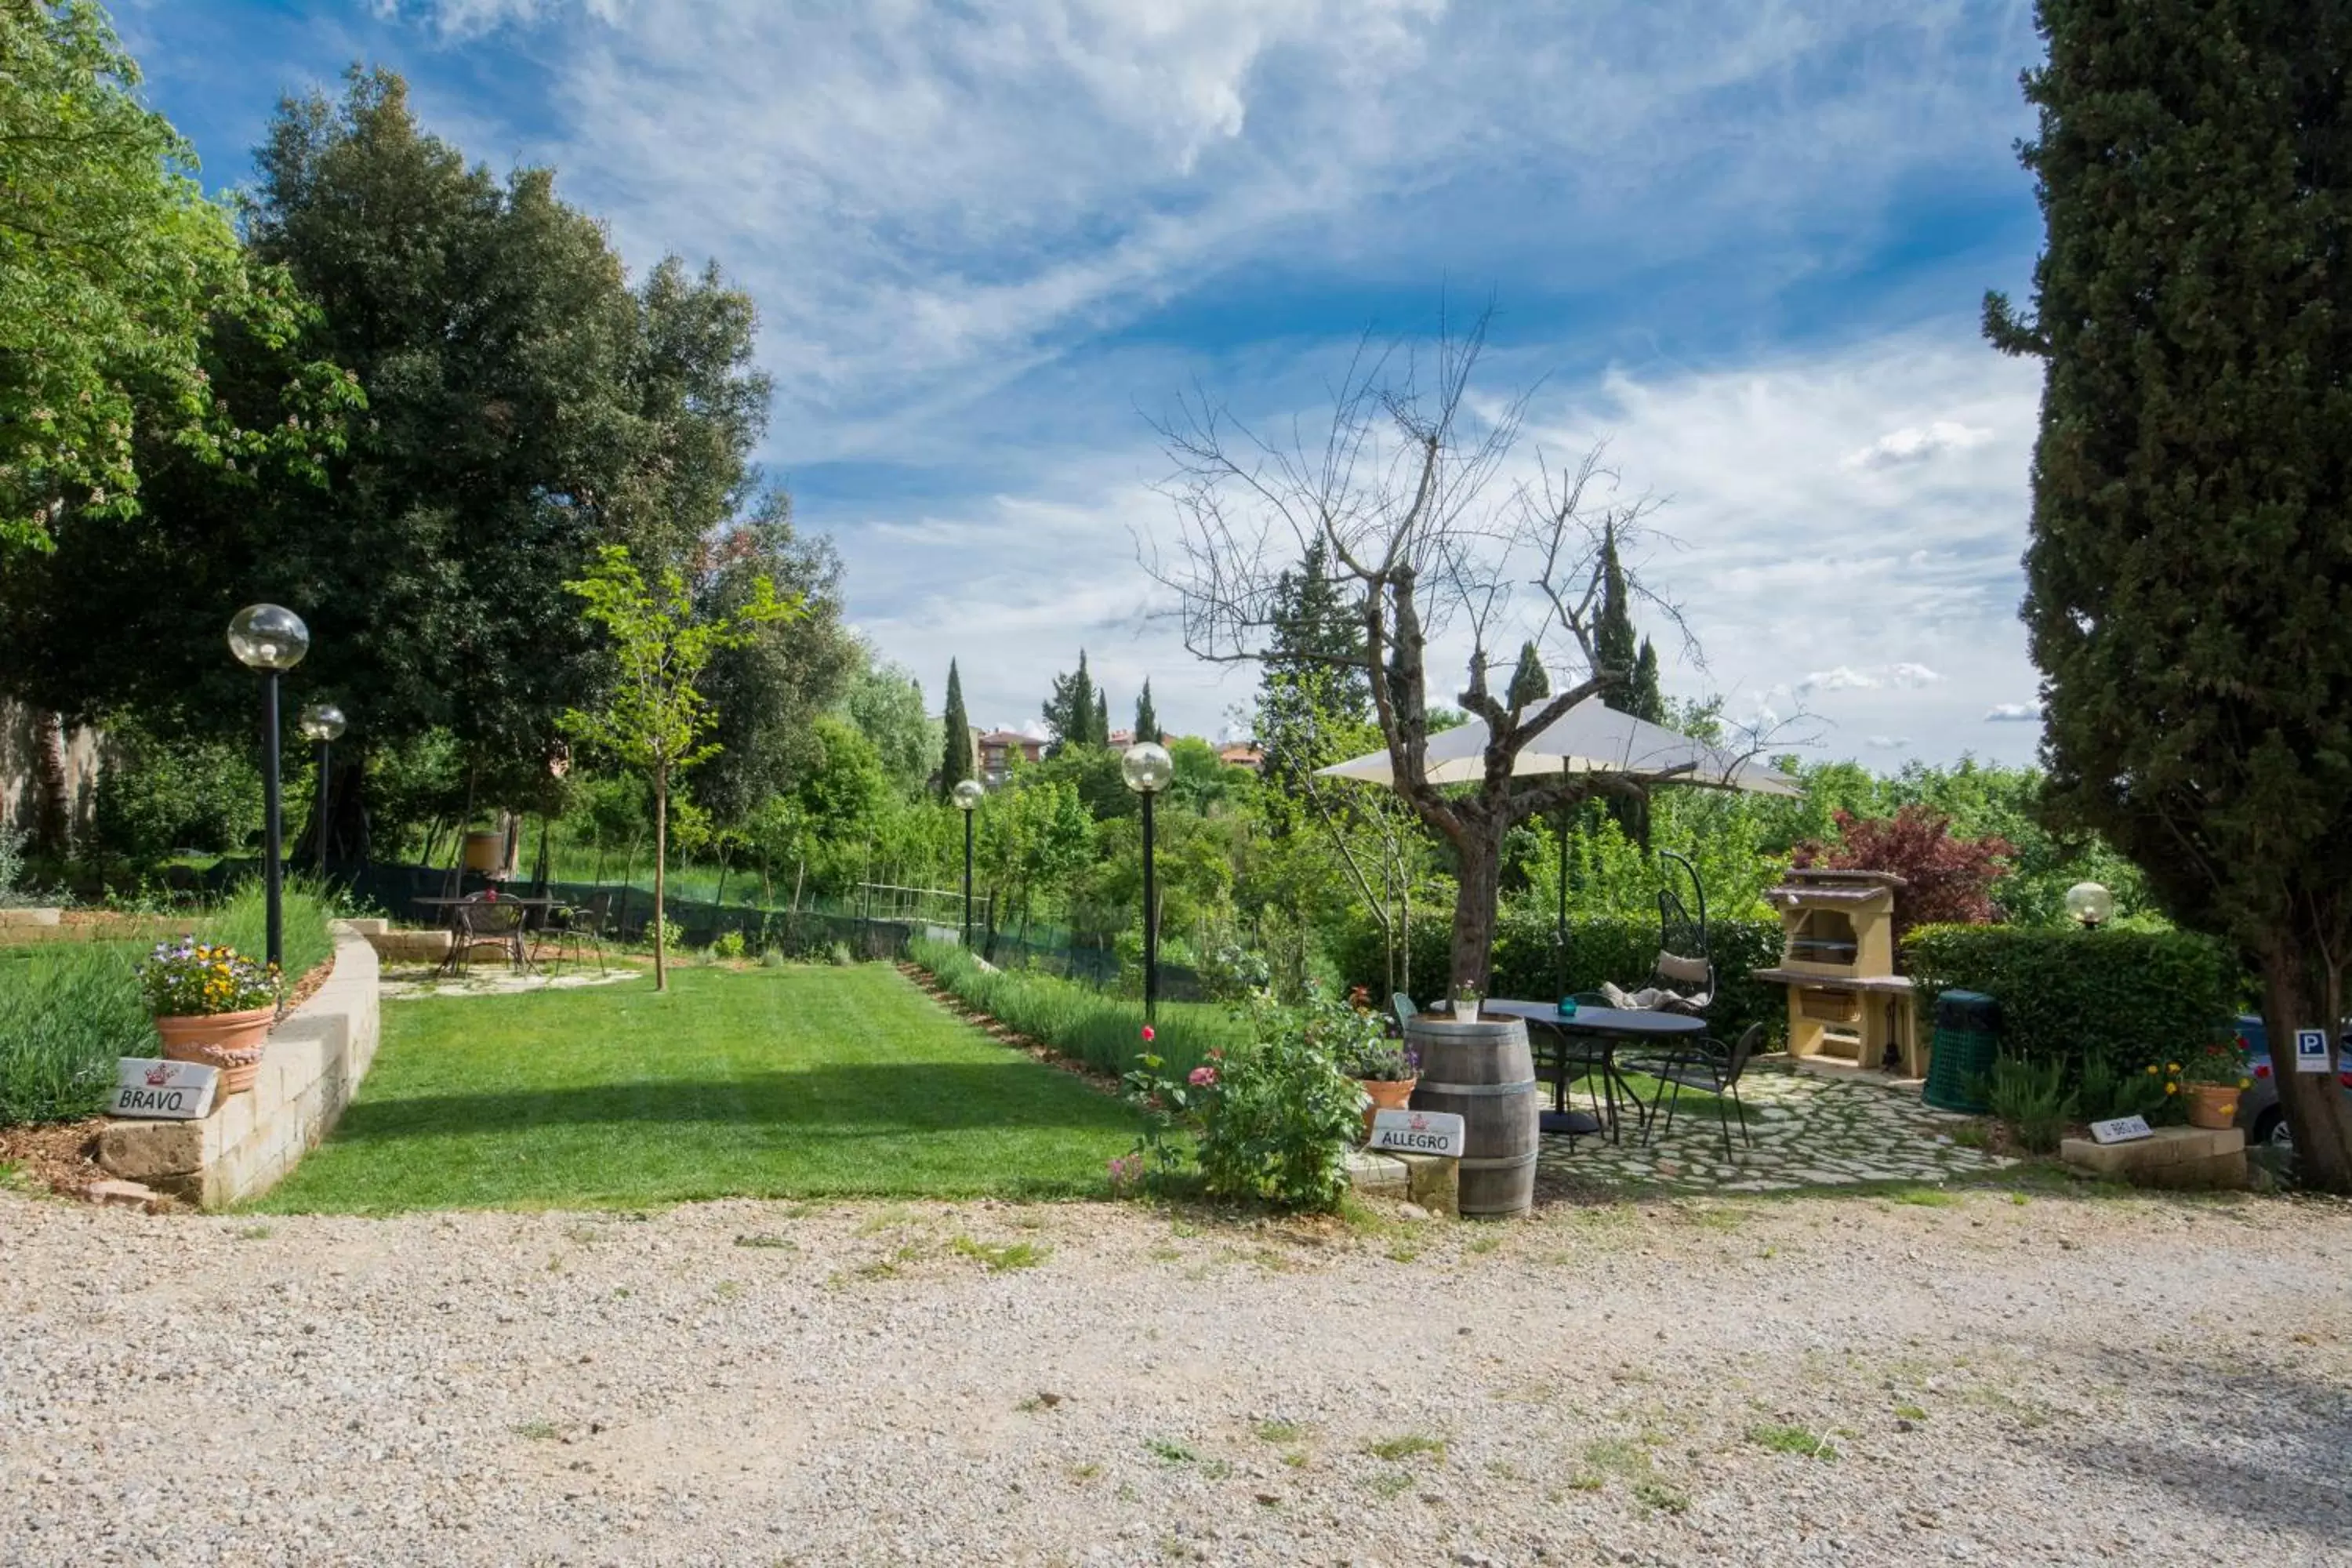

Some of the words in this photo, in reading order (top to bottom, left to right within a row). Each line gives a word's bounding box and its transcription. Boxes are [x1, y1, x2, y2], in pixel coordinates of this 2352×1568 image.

[2304, 1035, 2319, 1053] P
[118, 1089, 183, 1111] BRAVO
[1382, 1131, 1449, 1150] ALLEGRO
